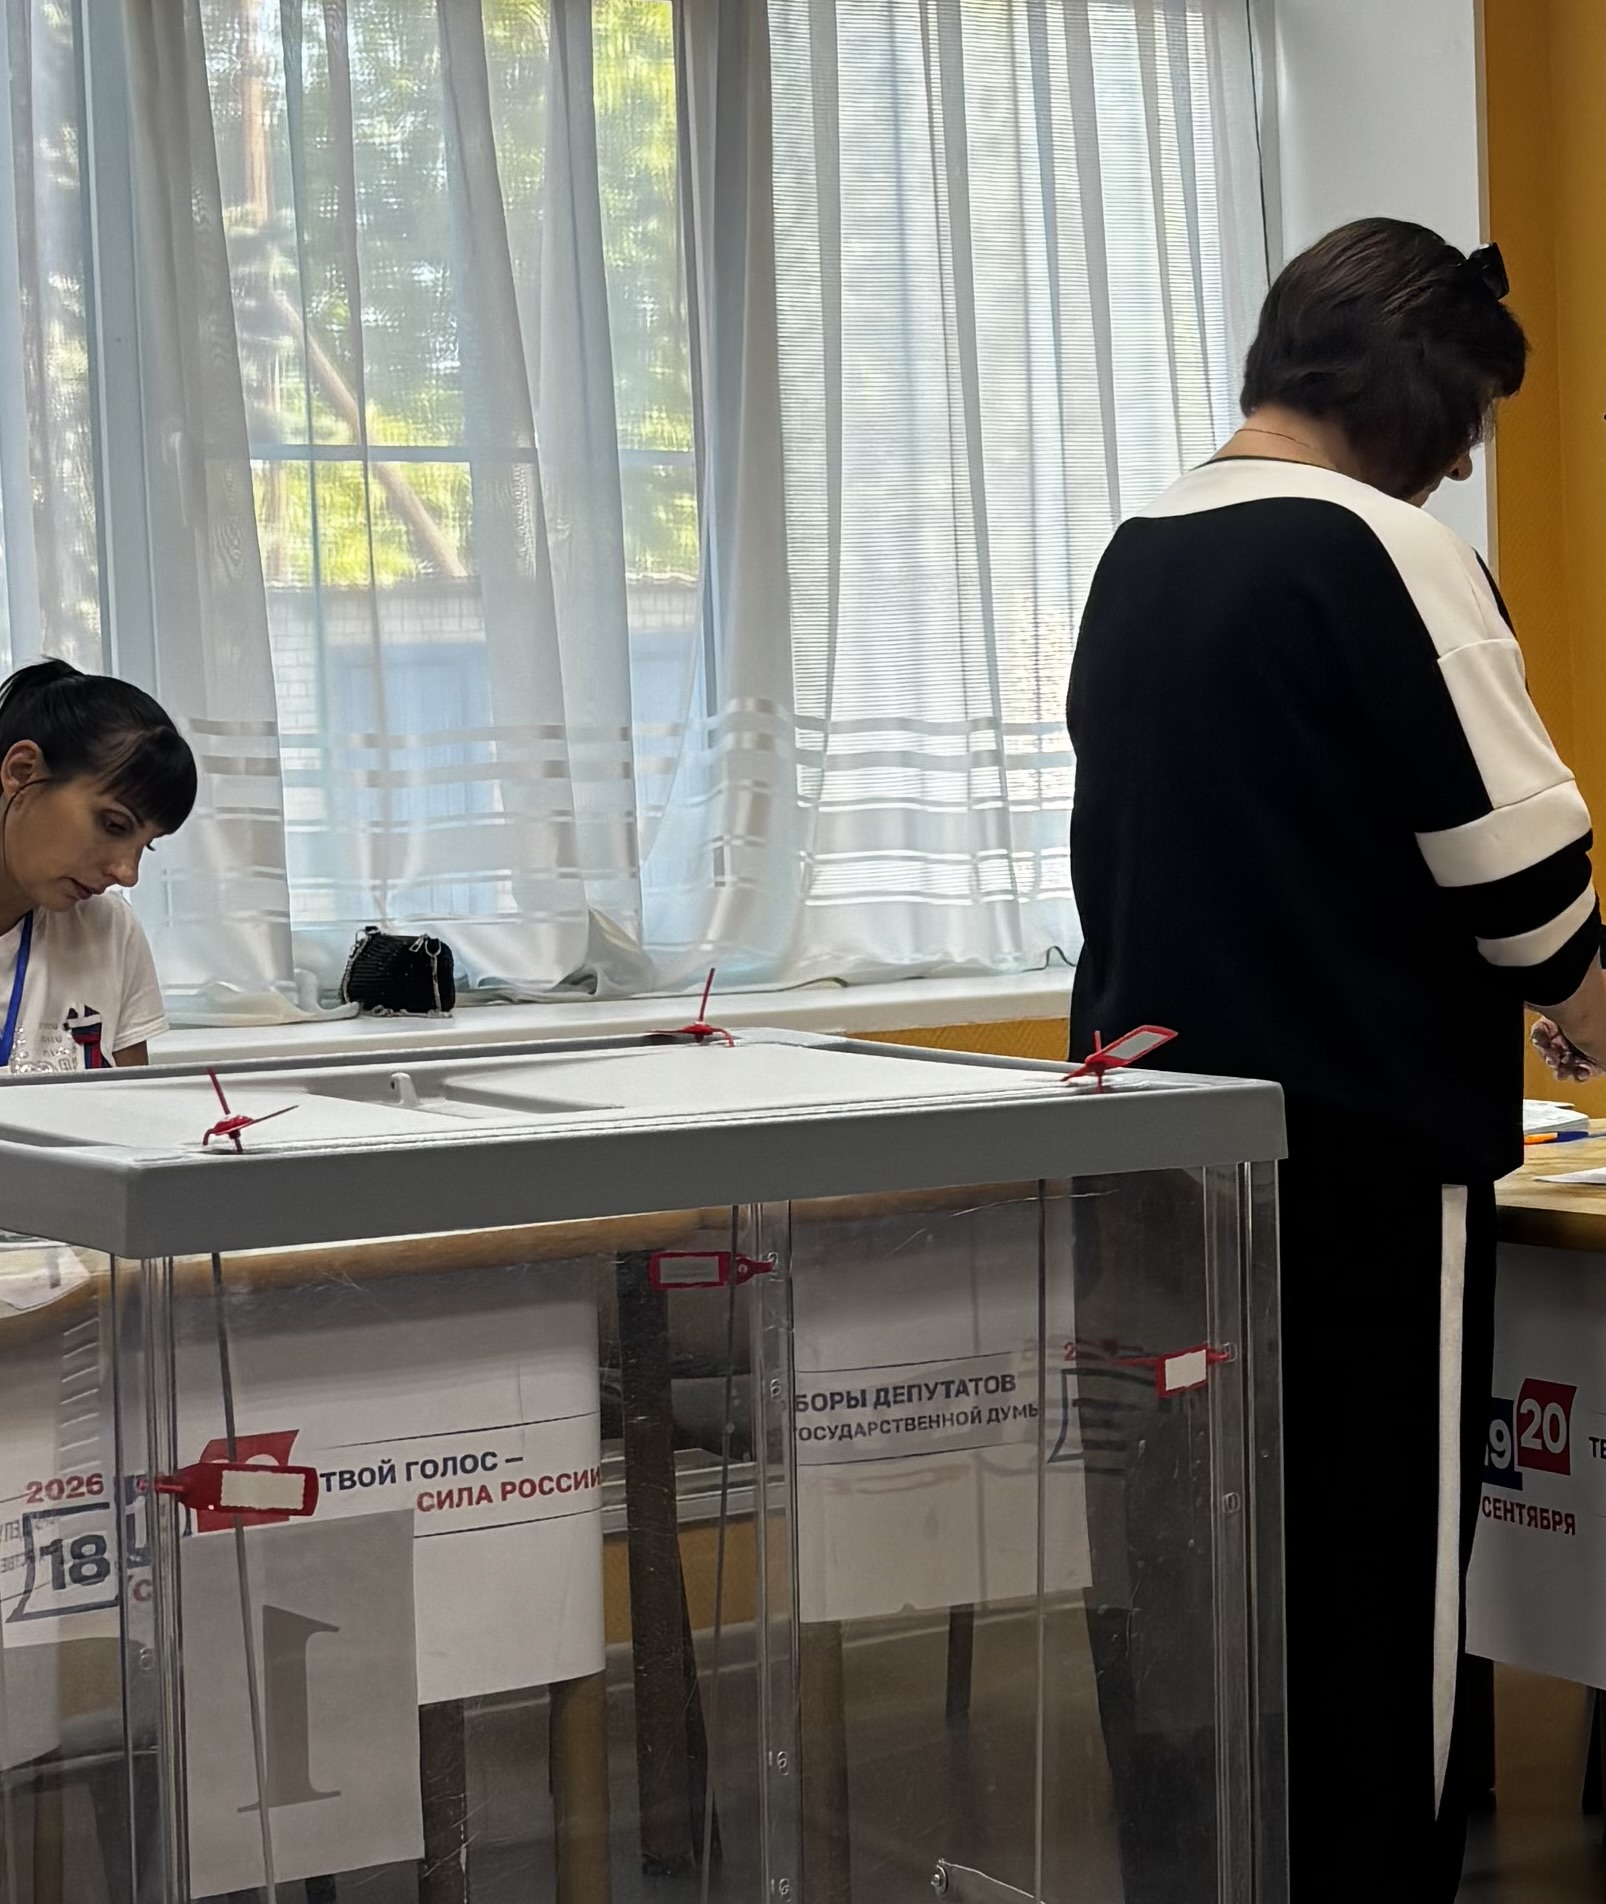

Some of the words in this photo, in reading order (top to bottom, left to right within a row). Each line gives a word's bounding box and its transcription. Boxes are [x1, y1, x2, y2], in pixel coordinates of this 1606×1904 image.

[795, 1388, 867, 1413] БОРЫ
[873, 1374, 1017, 1408] ДЕПУТАТОВ
[794, 1406, 983, 1441] ОСУДАРСТВЕННОЙ
[1485, 1419, 1512, 1470] 9
[1519, 1398, 1567, 1454] 20
[26, 1473, 104, 1504] 2026
[319, 1458, 396, 1492] ТВОЙ
[405, 1451, 498, 1482] ГОЛОС
[416, 1484, 493, 1513] СИЛА
[1482, 1496, 1576, 1536] СЕНТЯБРЯ
[39, 1534, 111, 1590] 18
